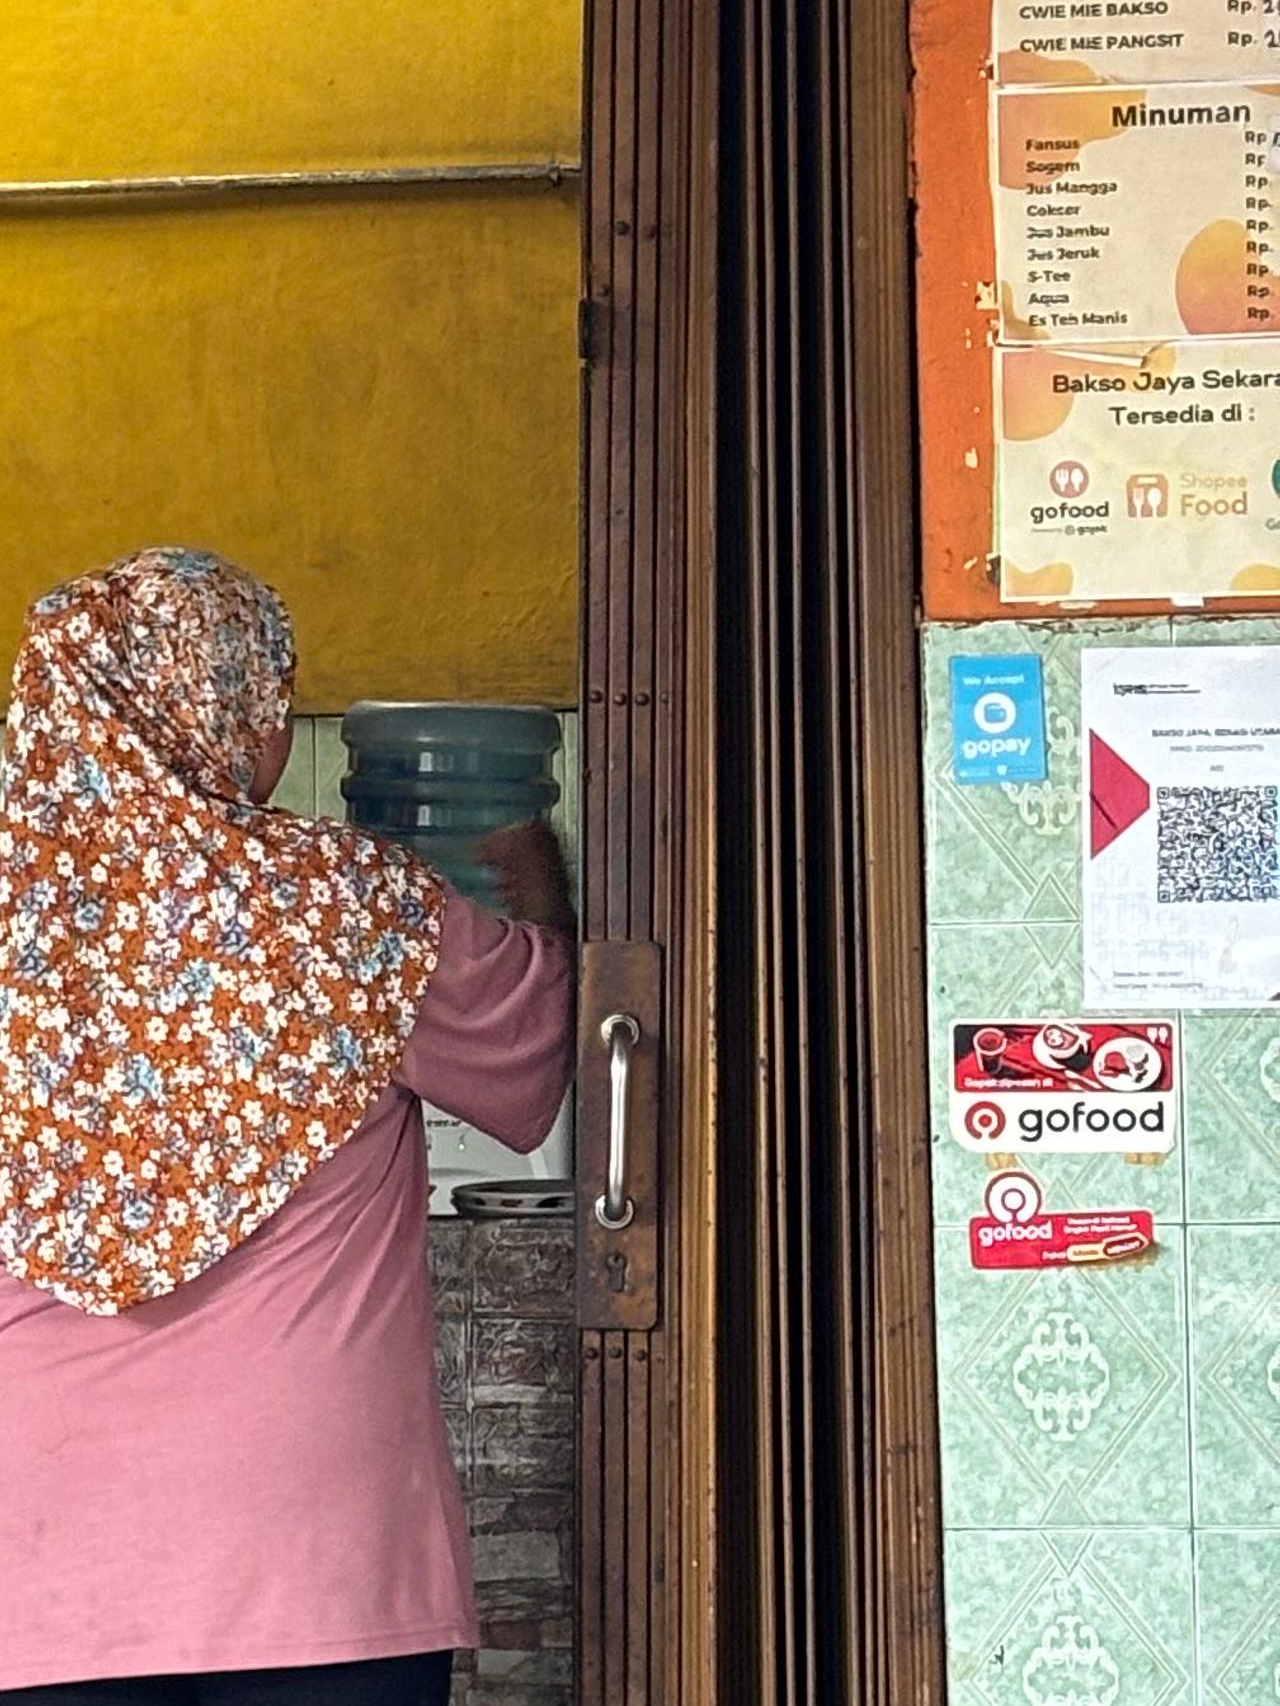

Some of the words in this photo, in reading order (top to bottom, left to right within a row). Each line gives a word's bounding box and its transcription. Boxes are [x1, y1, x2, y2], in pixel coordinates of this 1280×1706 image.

[1019, 4, 1066, 19] CWIE
[1070, 4, 1102, 18] MIE
[1106, 1, 1168, 16] BAKSO
[1020, 37, 1066, 52] CWIE
[1070, 36, 1103, 50] MIE
[1106, 33, 1184, 49] PANGSIT
[1112, 103, 1251, 127] Minuman
[1025, 139, 1080, 151] Fansus
[1026, 183, 1052, 194] Jus
[1056, 182, 1117, 195] Mangga
[1056, 225, 1109, 238] Jambu
[1057, 246, 1100, 260] Jeruk
[1028, 293, 1069, 307] Aqua
[1029, 315, 1046, 326] Es
[1051, 313, 1078, 327] Teh
[1082, 310, 1127, 324] Manis
[1052, 374, 1126, 393] Bakso
[1133, 372, 1195, 394] Jaya
[1108, 404, 1214, 425] Tersedia
[1180, 473, 1248, 490] Shopee
[1030, 501, 1109, 524] gofood
[1181, 492, 1248, 516] Food
[962, 737, 1032, 760] gopay
[1018, 1101, 1164, 1143] gofood
[978, 1220, 1052, 1247] gofood
